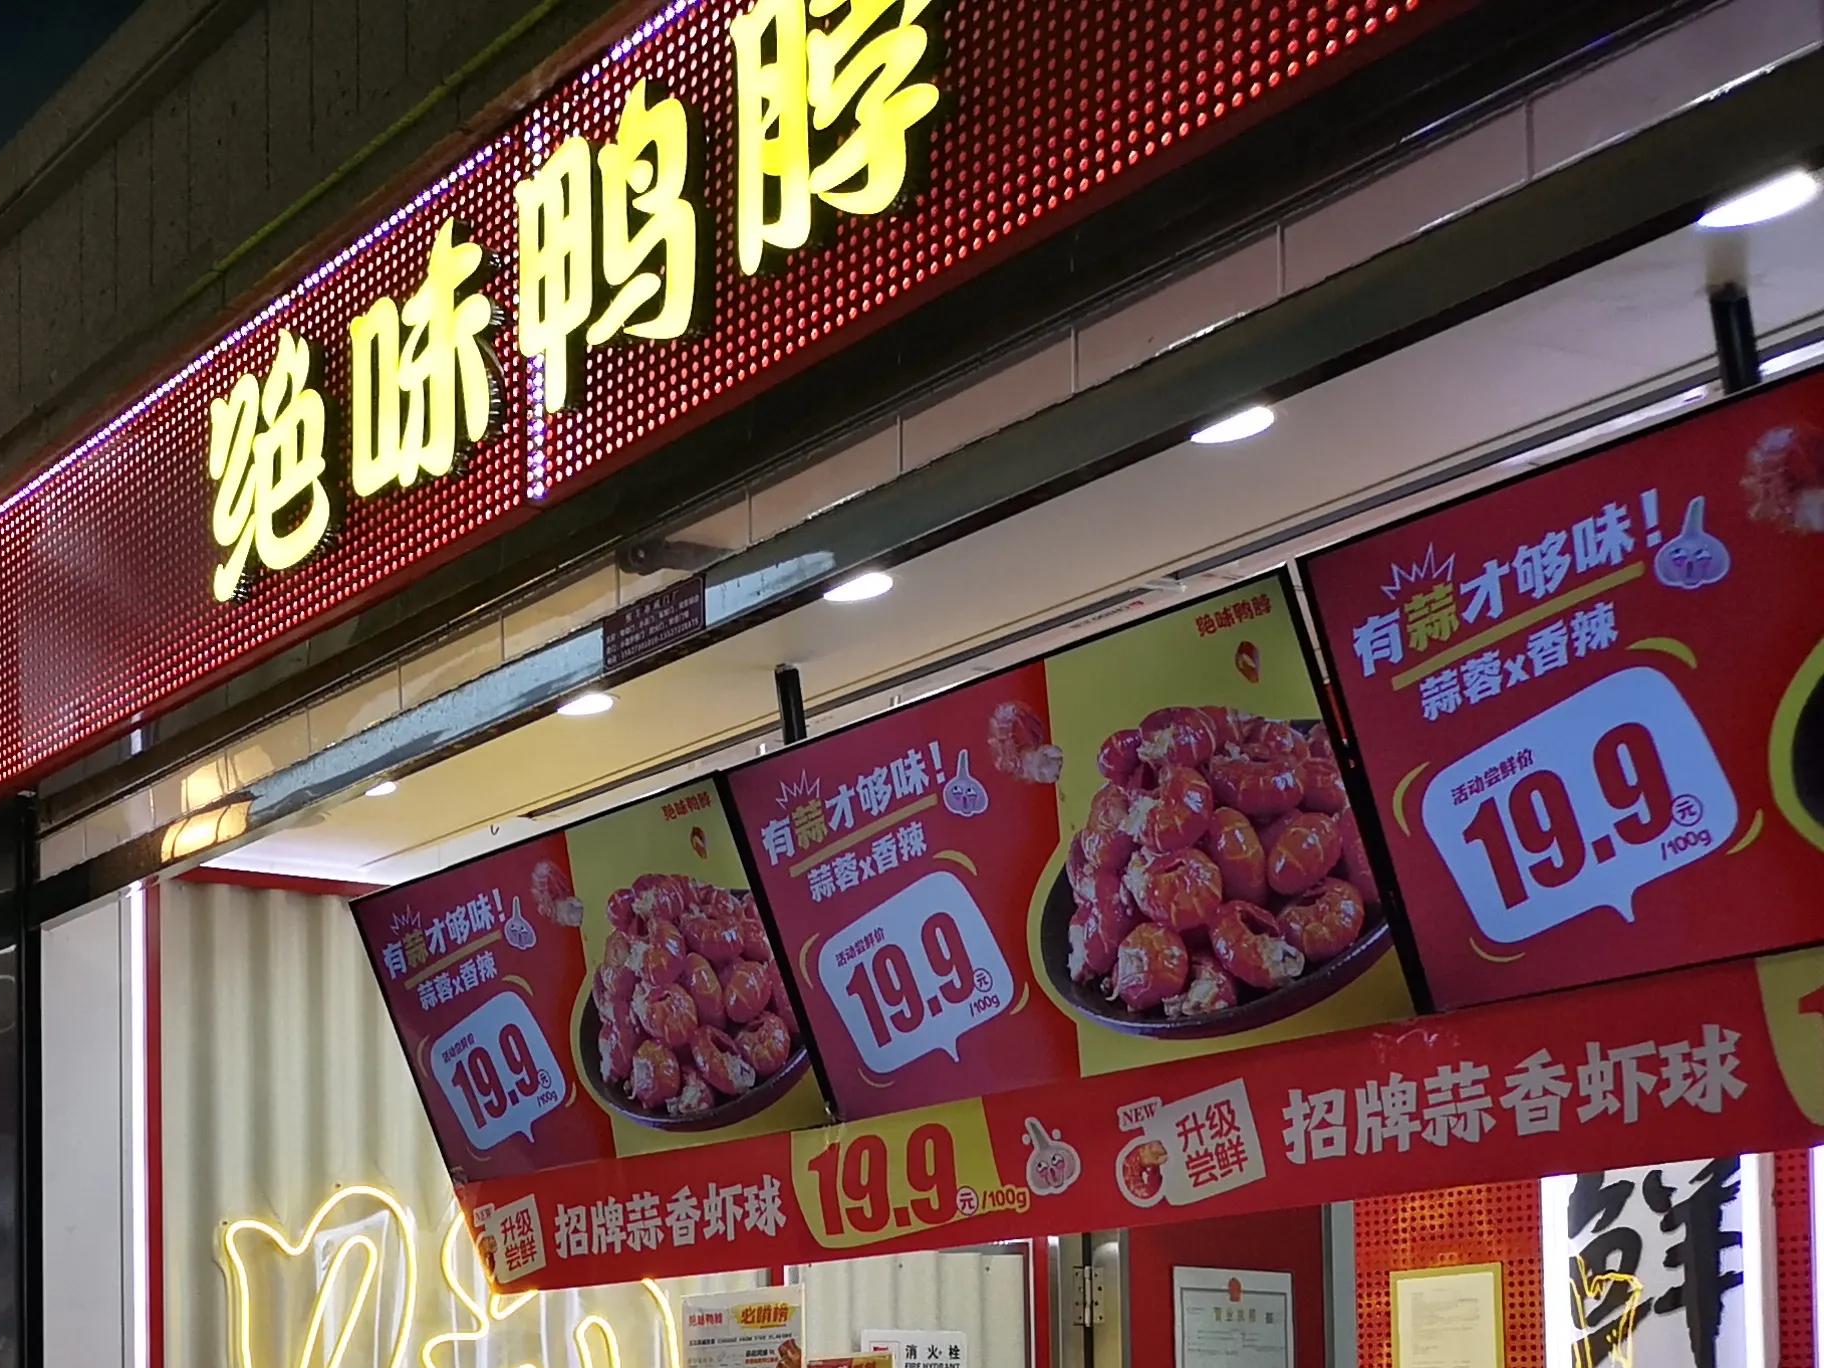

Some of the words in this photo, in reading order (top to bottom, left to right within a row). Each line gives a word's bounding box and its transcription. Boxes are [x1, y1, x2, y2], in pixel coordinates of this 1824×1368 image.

[207, 0, 939, 602] 绝味鸭脖
[1353, 488, 1666, 677] 有蒜才够味!
[761, 740, 946, 866] 有蒜才够味!
[1450, 747, 1535, 806] 活动尝鲜价
[1462, 722, 1678, 910] 19.9
[383, 888, 506, 978] 有蒜才够味!
[846, 912, 975, 1048] 19.9
[451, 1023, 539, 1131] 19.9
[1123, 1102, 1157, 1126] NEW
[1283, 1024, 1748, 1164] 招牌蒜香虾球
[1176, 1099, 1240, 1152] 升级
[1185, 1136, 1248, 1187] 尝鲜
[555, 1174, 787, 1259] 招牌蒜香虾球
[808, 1123, 958, 1235] 19.9
[501, 1208, 534, 1245] 升级
[505, 1237, 536, 1271] 尝鲜
[905, 1344, 961, 1360] 消火栓
